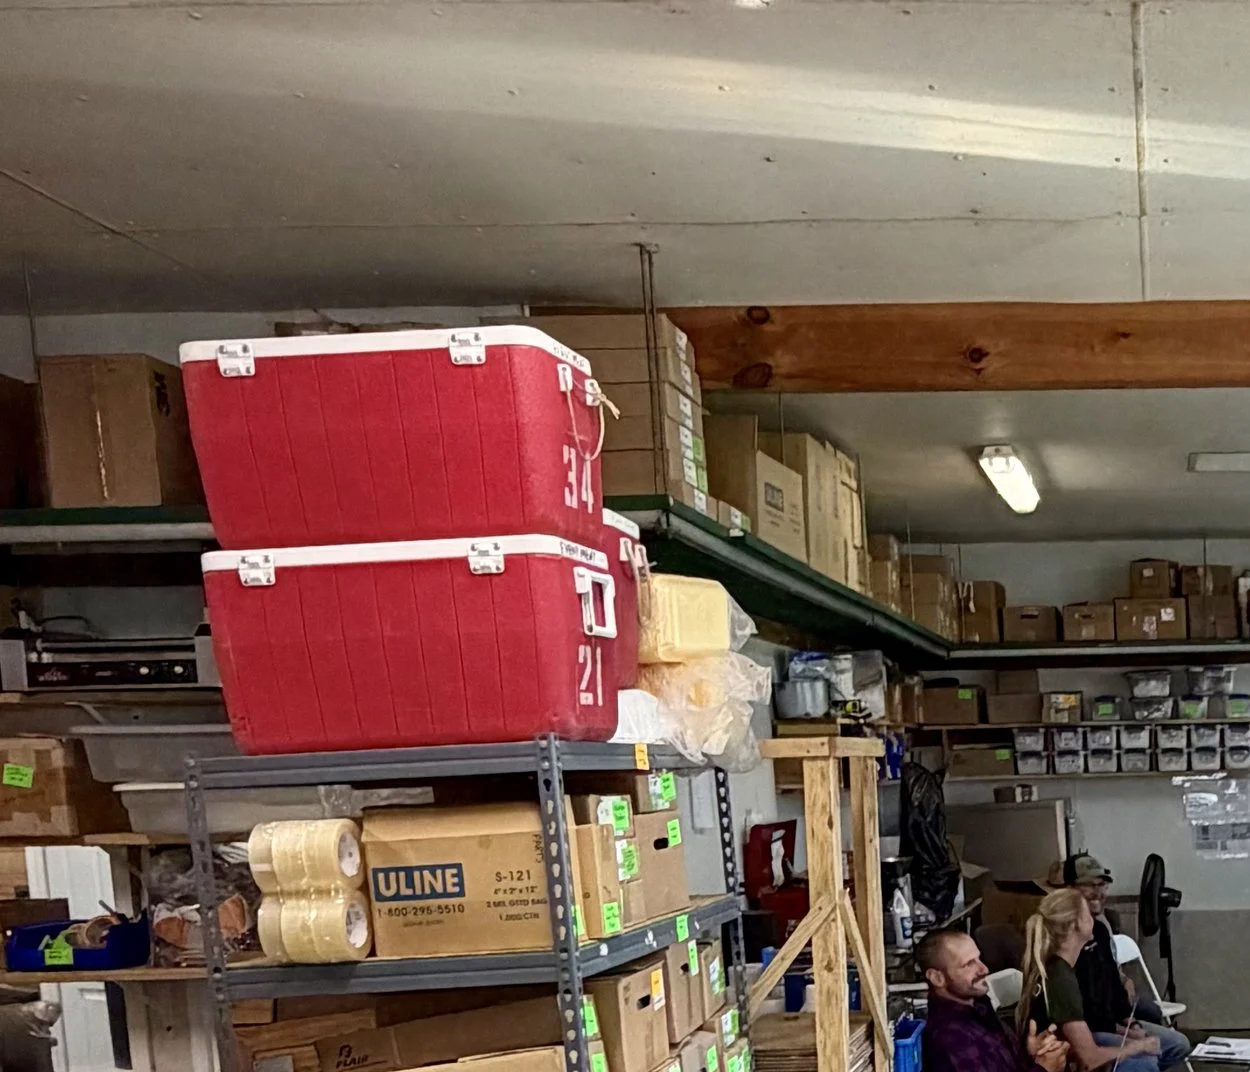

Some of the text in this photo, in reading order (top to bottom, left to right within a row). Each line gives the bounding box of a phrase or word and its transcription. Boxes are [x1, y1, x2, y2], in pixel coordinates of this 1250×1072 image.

[562, 444, 594, 514] 34
[578, 644, 603, 706] 21
[377, 867, 460, 897] ULINE
[495, 869, 531, 882] S-121
[378, 903, 465, 918] 1-800-295-5510
